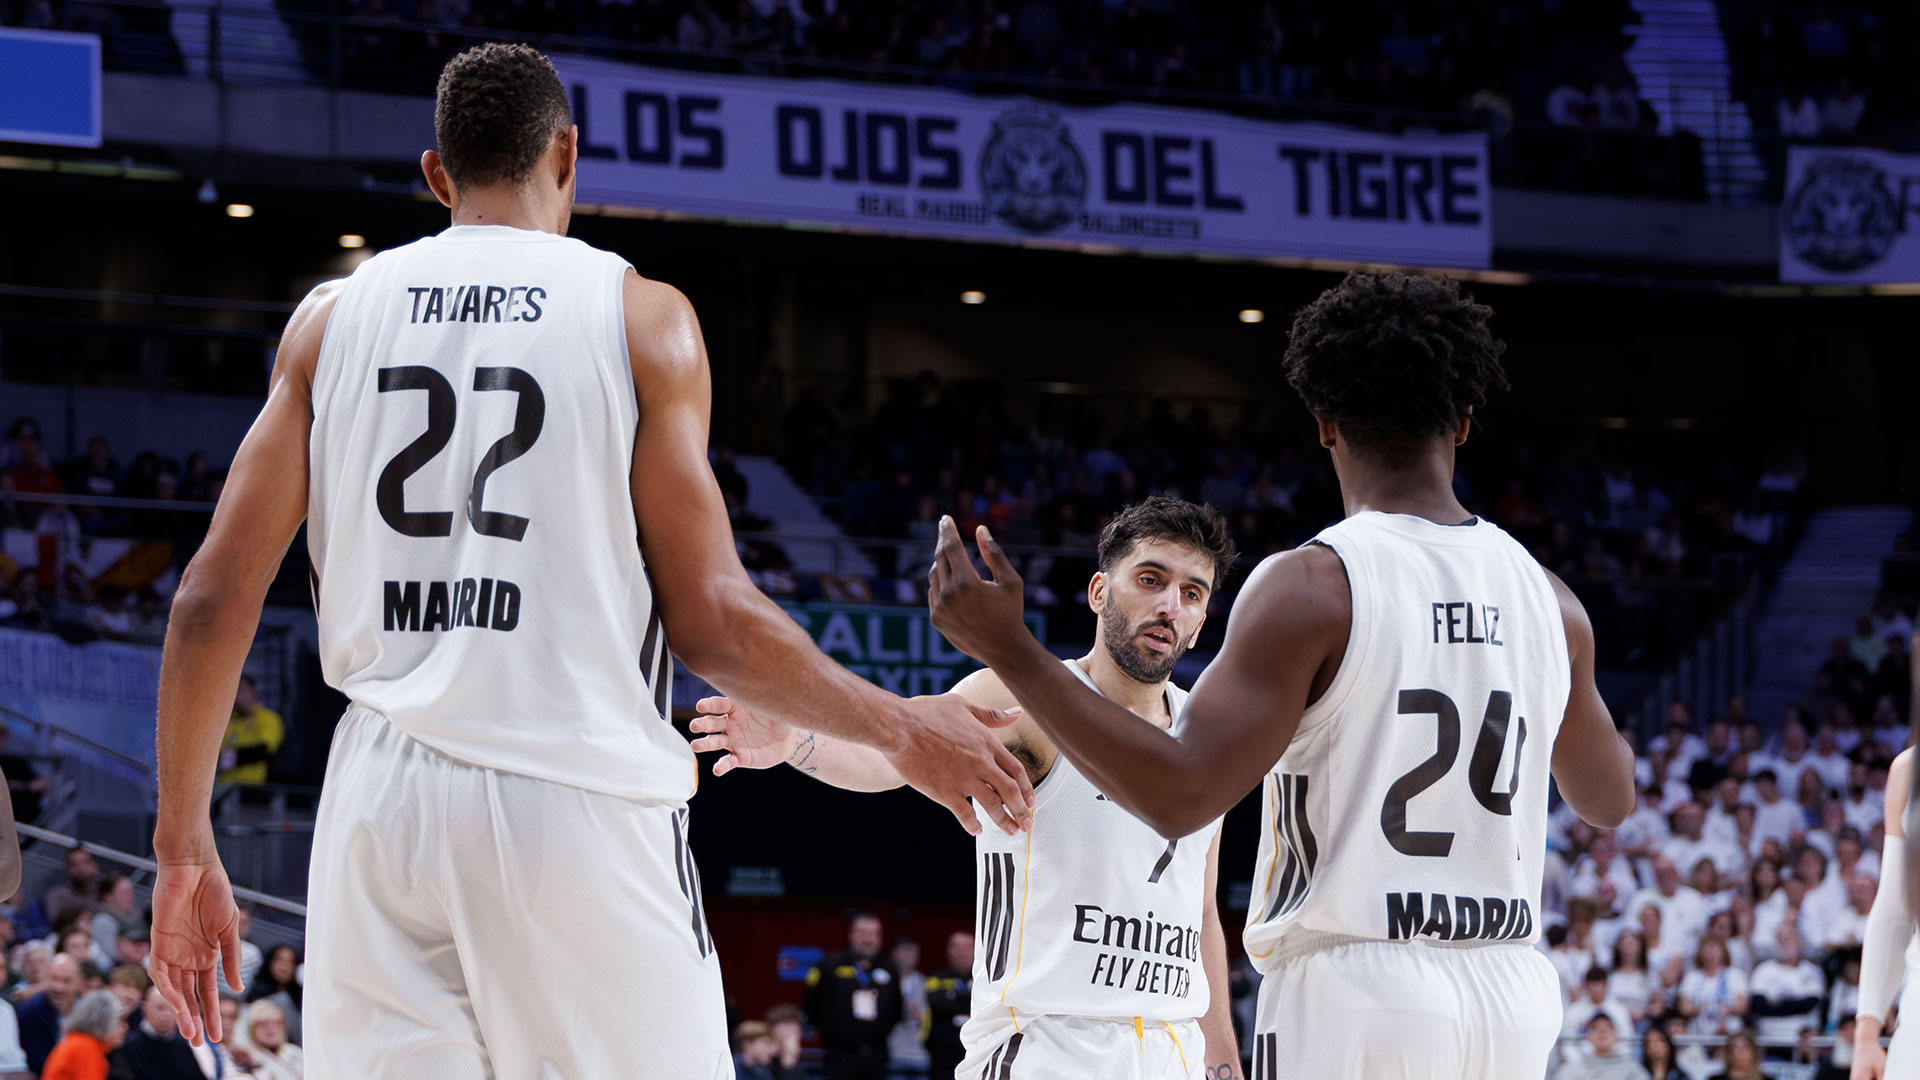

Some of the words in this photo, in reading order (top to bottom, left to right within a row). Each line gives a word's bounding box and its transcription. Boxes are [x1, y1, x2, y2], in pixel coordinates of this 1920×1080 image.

[572, 85, 724, 170] LOS
[776, 102, 961, 190] OJOS
[1103, 131, 1245, 212] DEL
[1279, 145, 1481, 227] TIGRE
[408, 285, 547, 324] TAVARES
[376, 365, 546, 540] 22
[384, 578, 522, 632] MARID
[1432, 602, 1504, 646] FELIZ
[792, 610, 970, 665] ALID
[1380, 688, 1528, 860] 24
[1073, 904, 1200, 963] Emirate
[1386, 892, 1533, 941] MADRID
[1091, 953, 1135, 989] FLY
[1135, 960, 1191, 1000] BETTER
